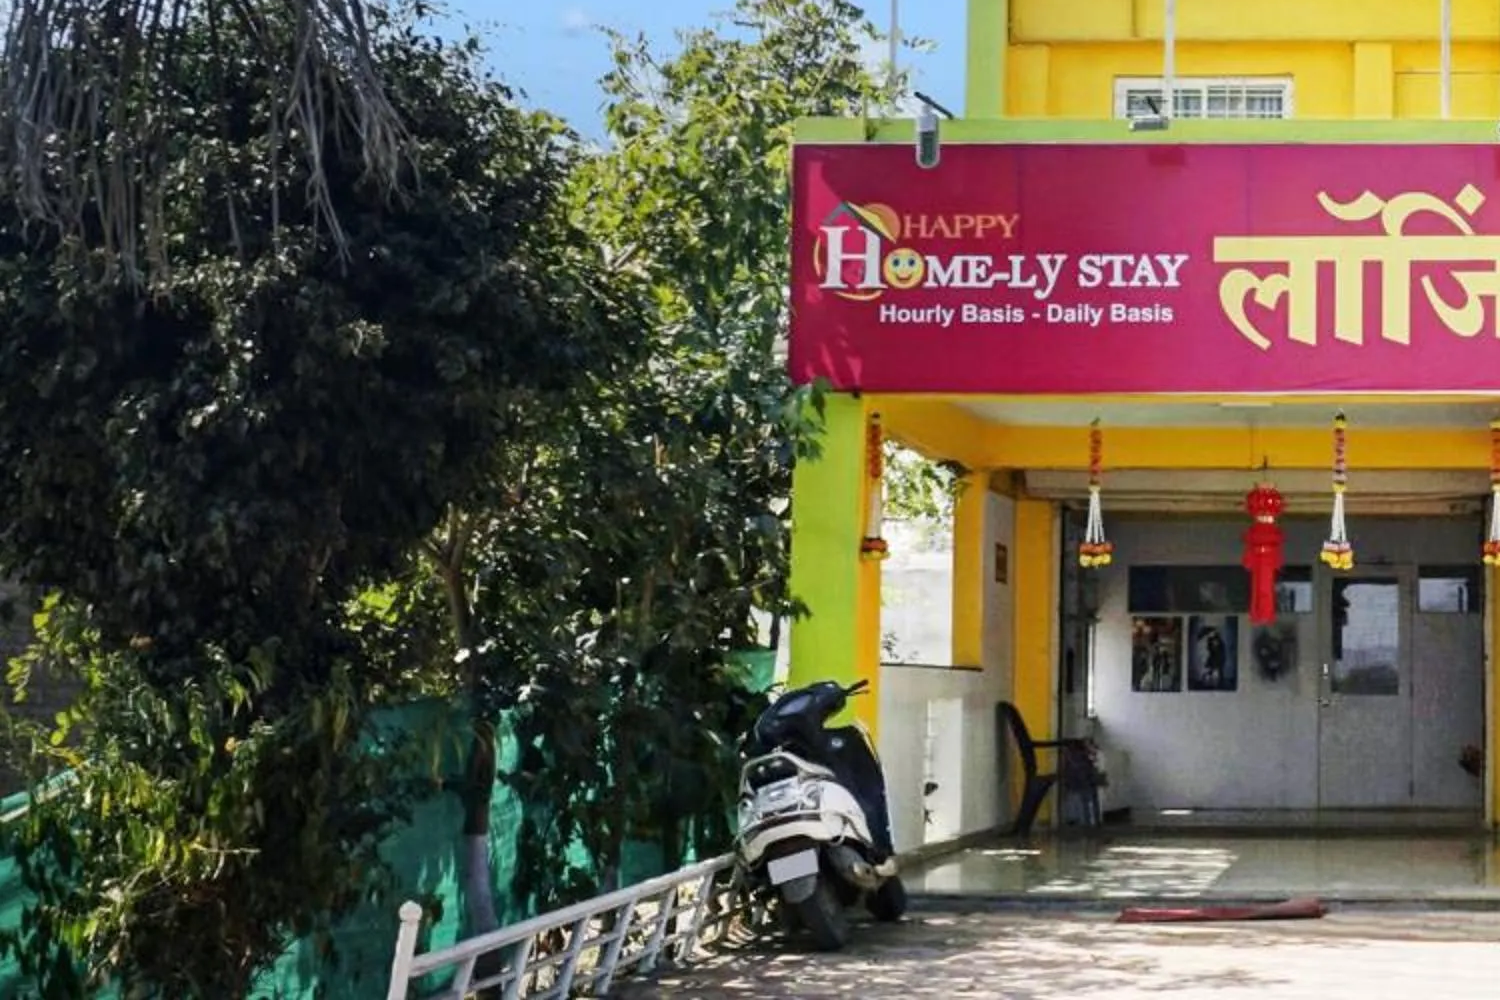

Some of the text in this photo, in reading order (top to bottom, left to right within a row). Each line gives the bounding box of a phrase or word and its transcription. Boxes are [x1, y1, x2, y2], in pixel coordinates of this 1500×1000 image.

[903, 214, 1020, 239] HAPPY
[1078, 254, 1189, 288] STAY
[879, 304, 954, 327] Hourly
[961, 304, 1025, 323] Basis
[1046, 304, 1102, 327] Daily
[1110, 304, 1173, 323] Basis
